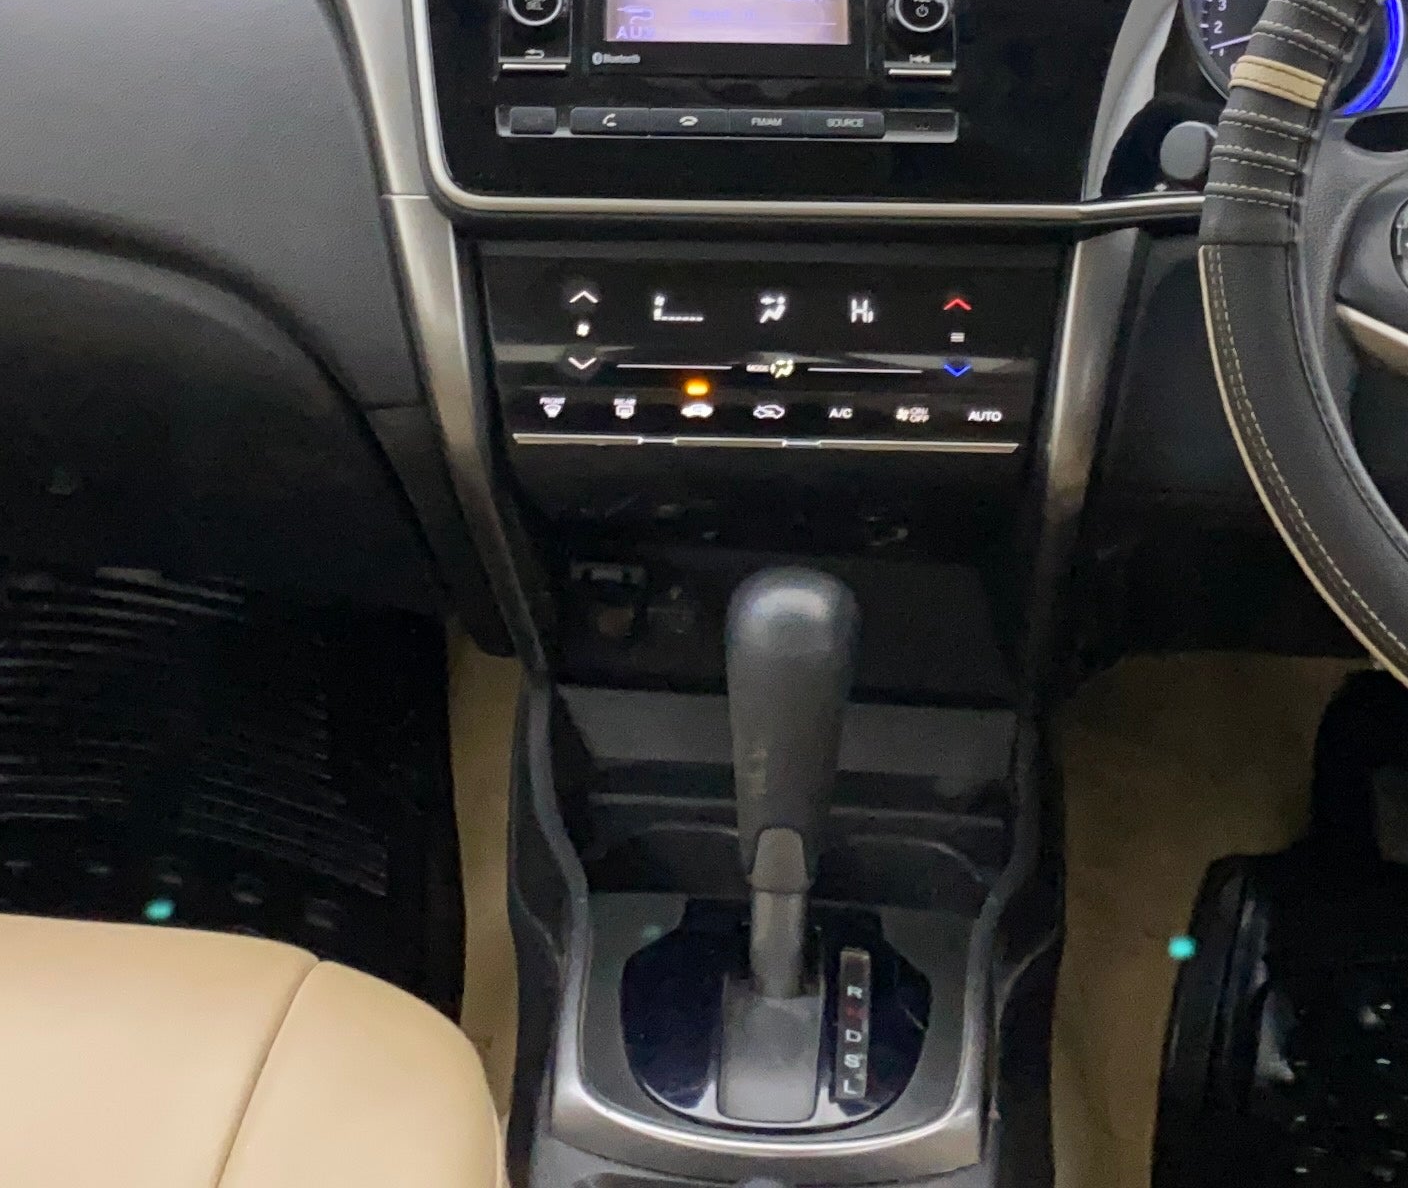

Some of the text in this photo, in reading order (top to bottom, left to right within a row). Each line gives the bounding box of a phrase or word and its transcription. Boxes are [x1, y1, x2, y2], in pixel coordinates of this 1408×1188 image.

[1214, 20, 1222, 34] 2
[826, 118, 864, 128] SOURCE
[829, 408, 853, 419] A/C
[968, 410, 1003, 422] AUTO
[847, 985, 863, 999] R
[845, 1029, 862, 1042] D
[843, 1079, 857, 1095] L
